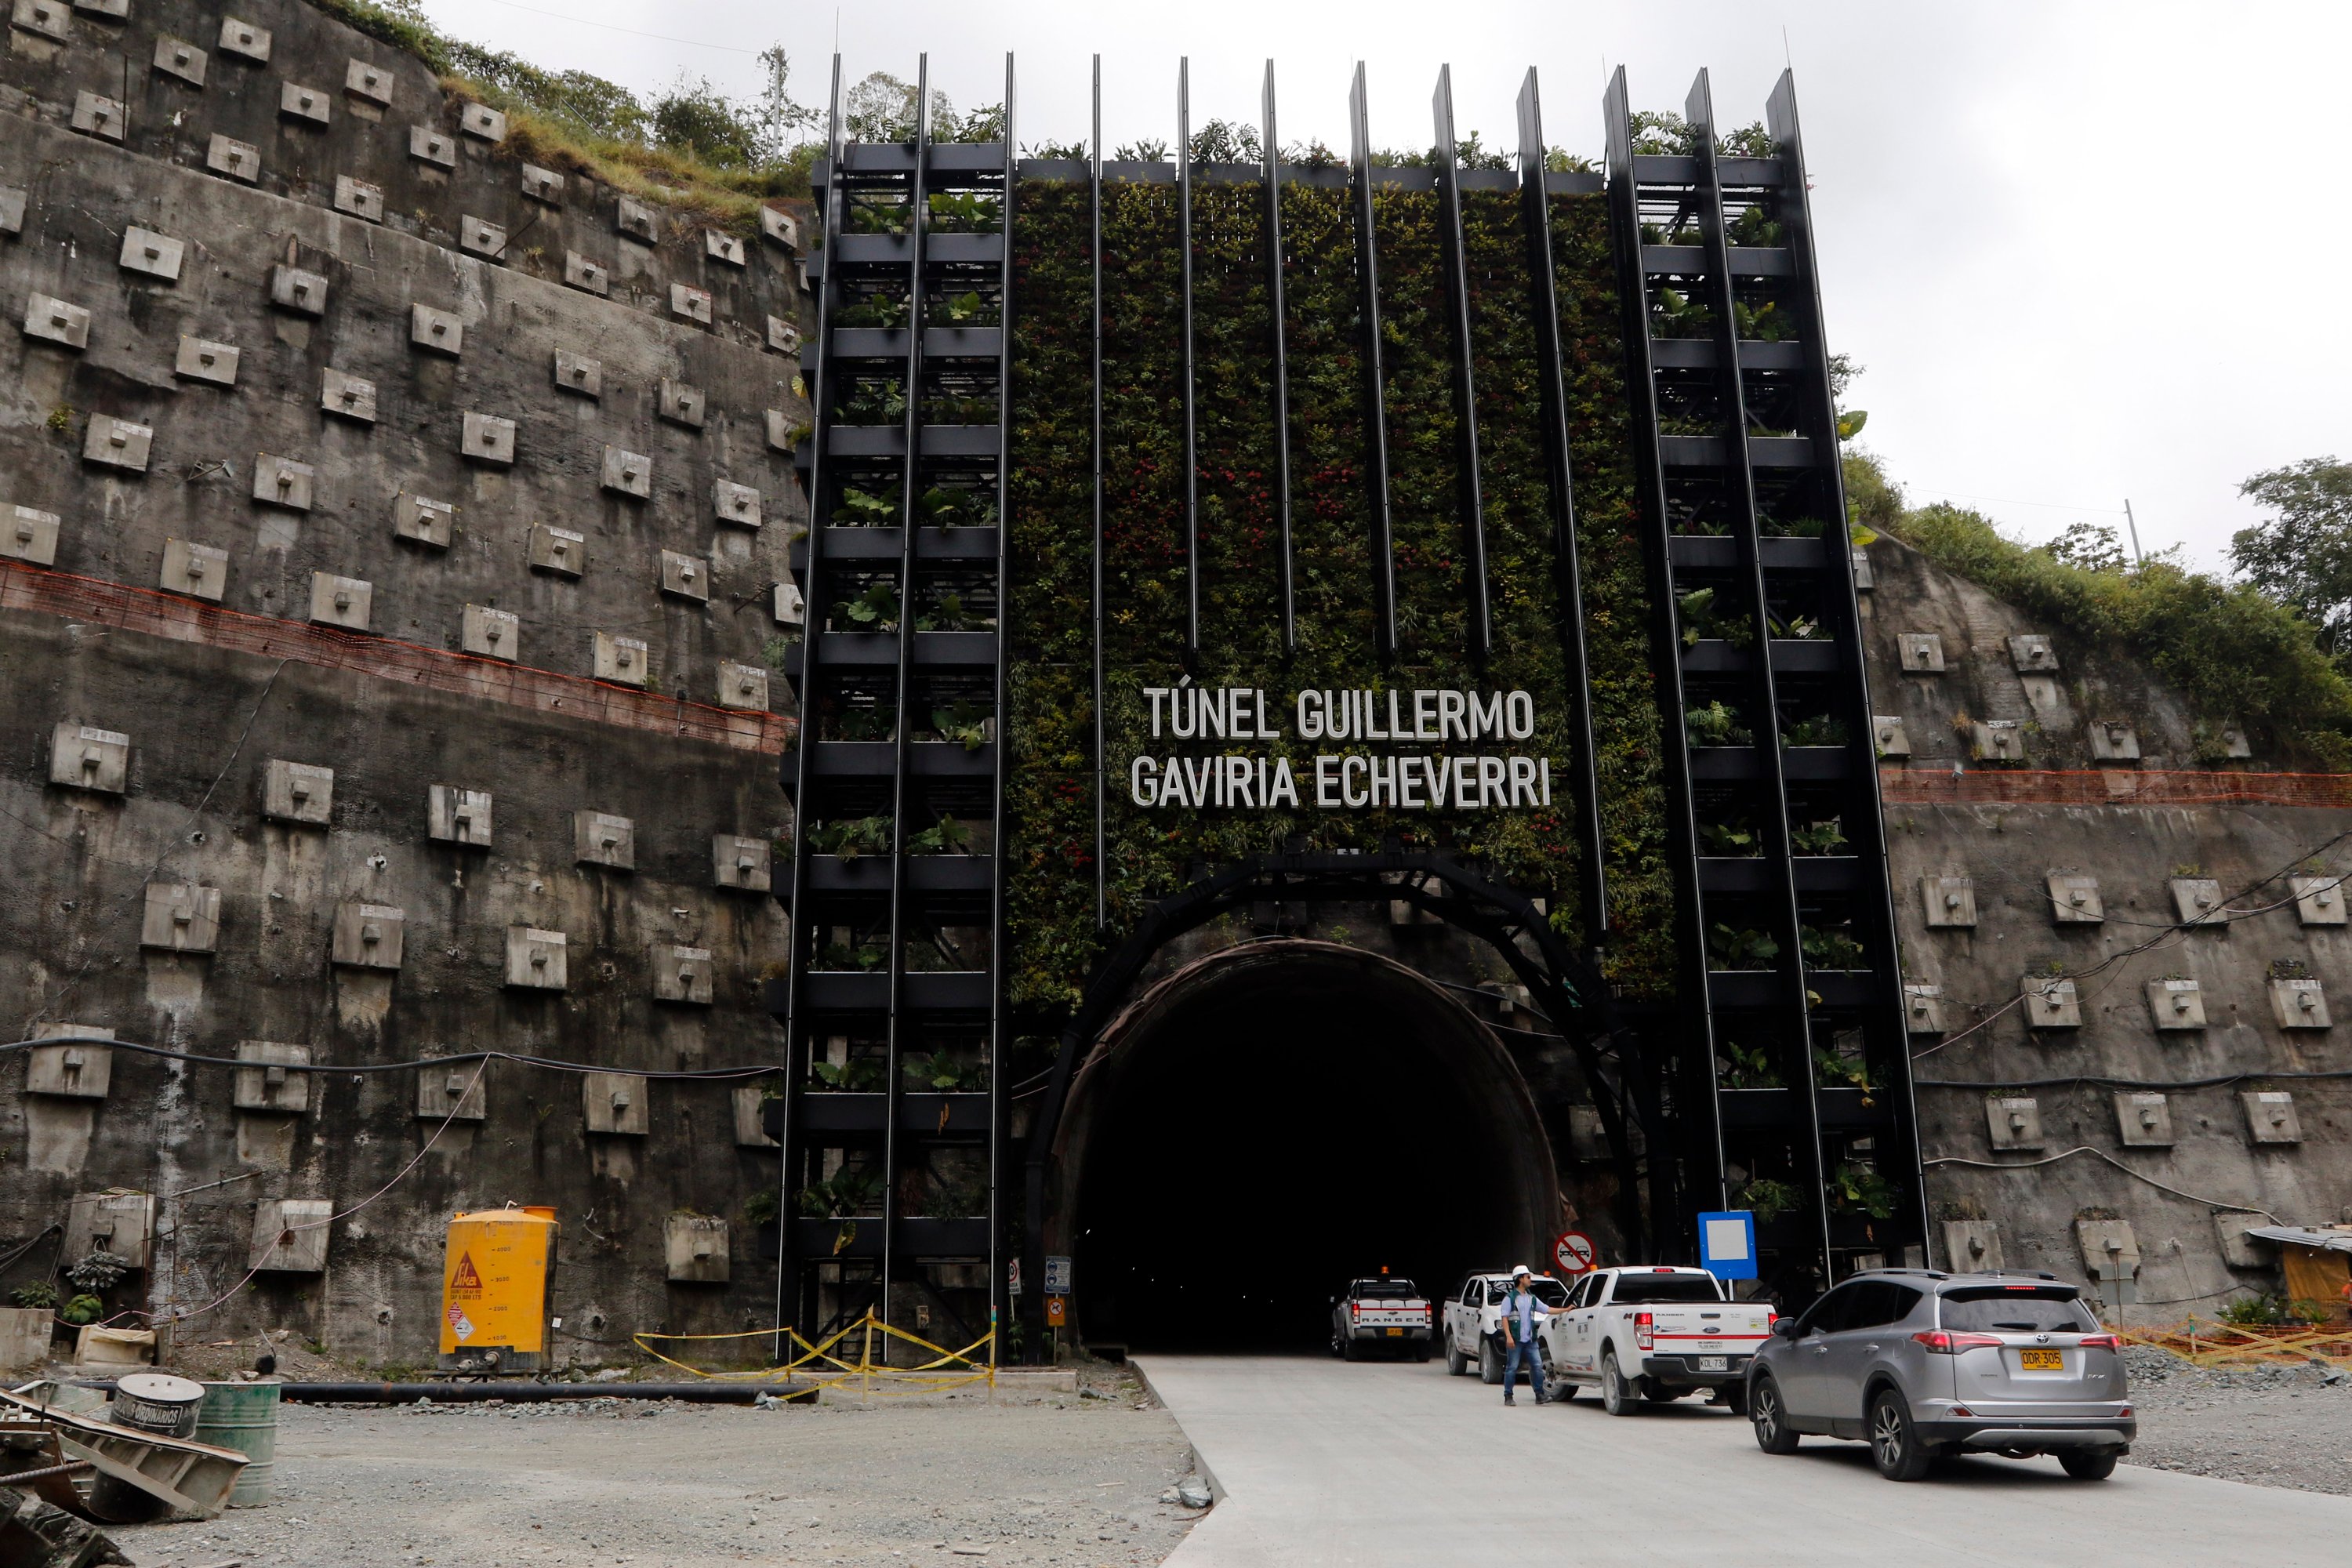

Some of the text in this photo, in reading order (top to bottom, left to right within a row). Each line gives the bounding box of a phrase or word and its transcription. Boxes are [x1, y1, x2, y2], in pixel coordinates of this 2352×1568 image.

[1143, 673, 1534, 741] TÚNEL GUILLERMO
[1131, 755, 1551, 809] GAVIRIA ECHEVERRI
[453, 1262, 477, 1287] Sika
[1700, 1359, 1726, 1367] KOL 736
[2022, 1352, 2061, 1364] ODR 305
[135, 1403, 179, 1424] ORDINARIOS
